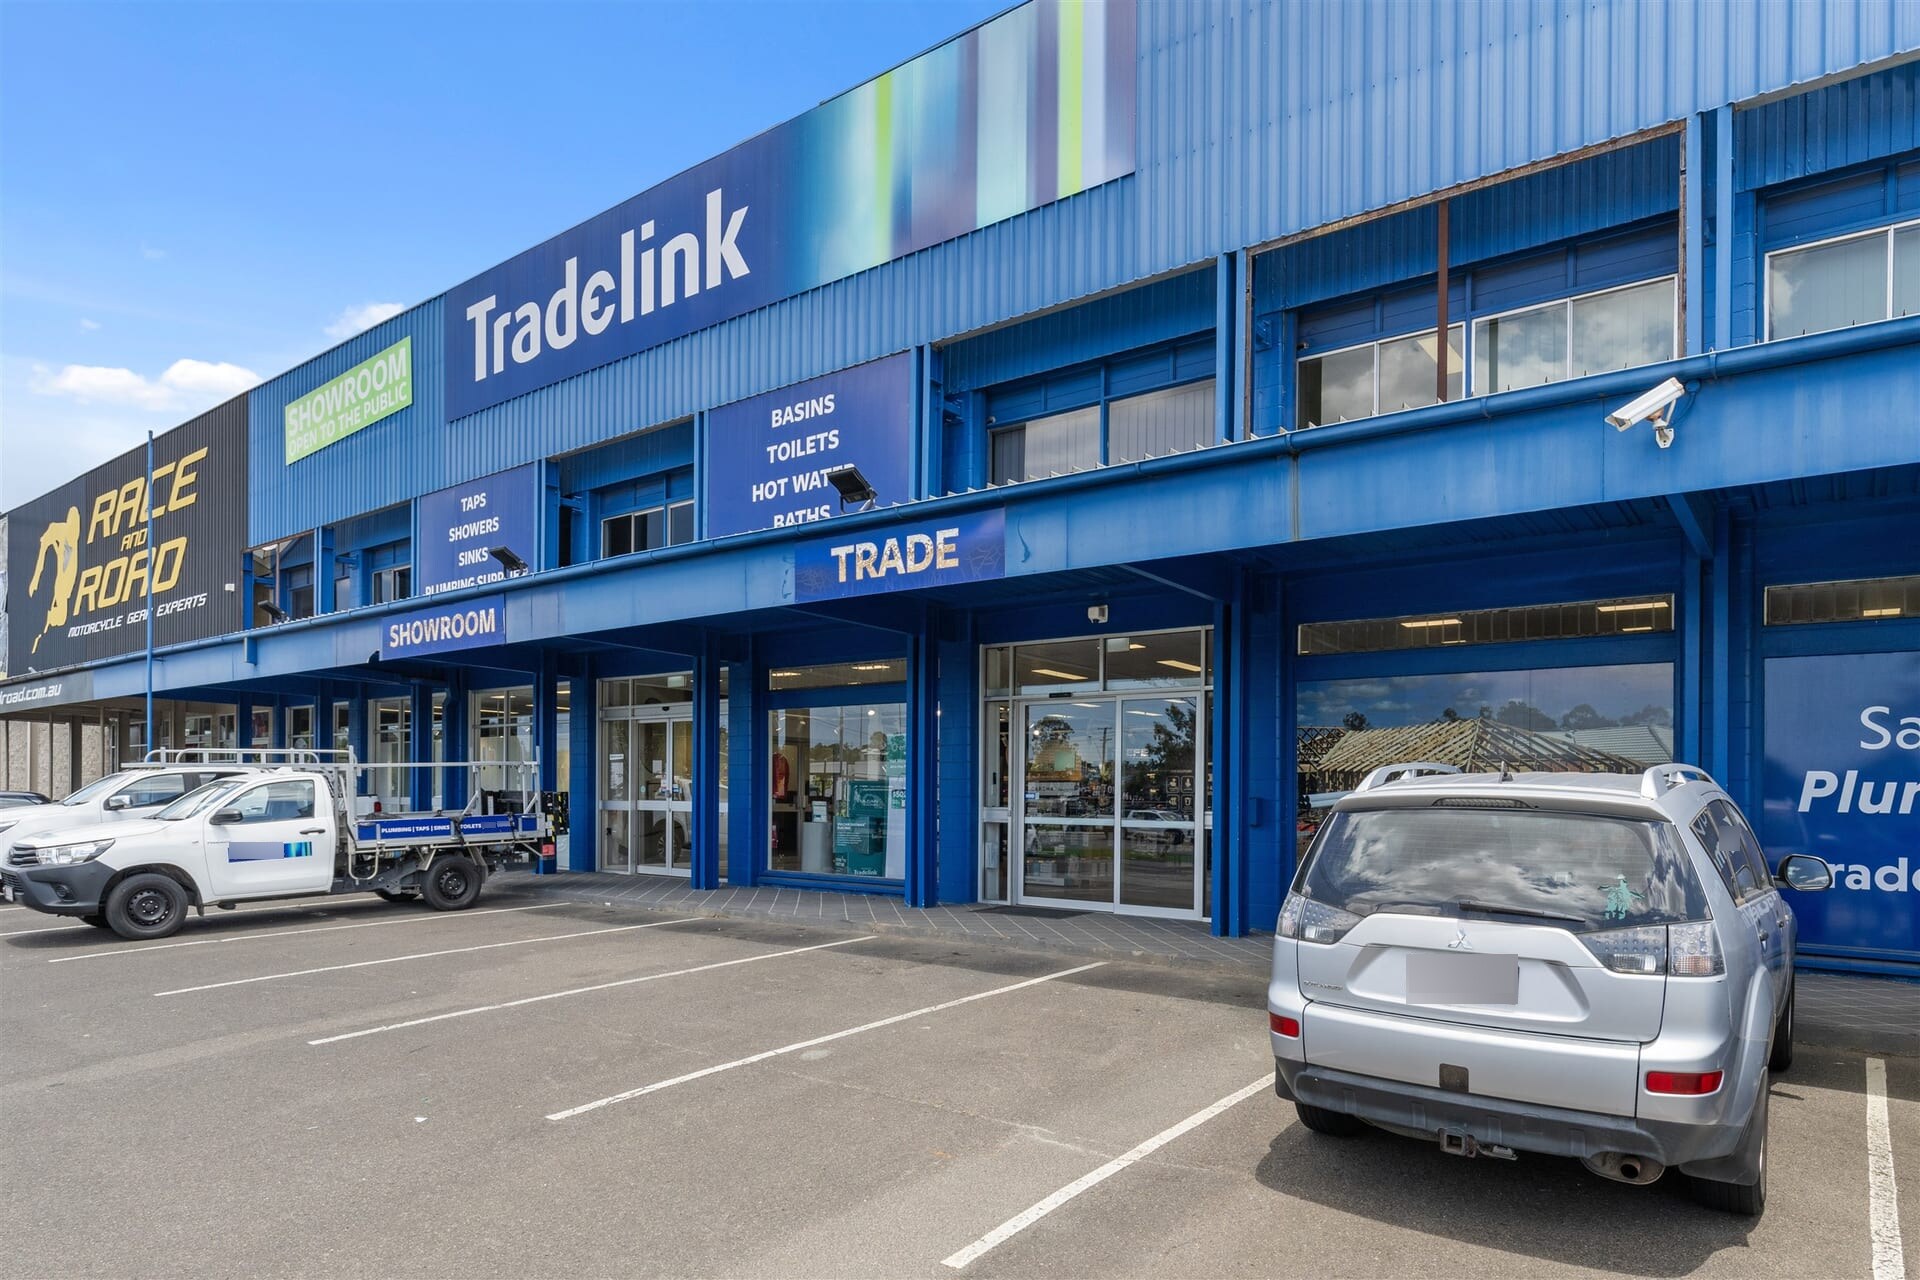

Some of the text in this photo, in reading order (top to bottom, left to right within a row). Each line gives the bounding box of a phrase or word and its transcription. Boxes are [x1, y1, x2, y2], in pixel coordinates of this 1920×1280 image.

[467, 188, 751, 382] Tradelink
[288, 347, 407, 437] SHOWROOM
[771, 394, 835, 428] BASINS
[289, 382, 407, 457] OPEN TO THE PUBLIC
[767, 430, 840, 464] TOILETS
[87, 447, 208, 544] RACE
[752, 463, 855, 502] HOT WAT
[461, 492, 487, 513] TAPS
[774, 504, 830, 529] BATHS
[121, 528, 148, 551] AND
[449, 516, 499, 542] SHOWERS
[458, 547, 489, 566] SINKS
[830, 527, 960, 583] TRADE
[73, 536, 187, 616] ROAD
[68, 593, 207, 638] MOTORCYCLE GEA EXPERTS
[389, 608, 496, 648] SHOWROOM
